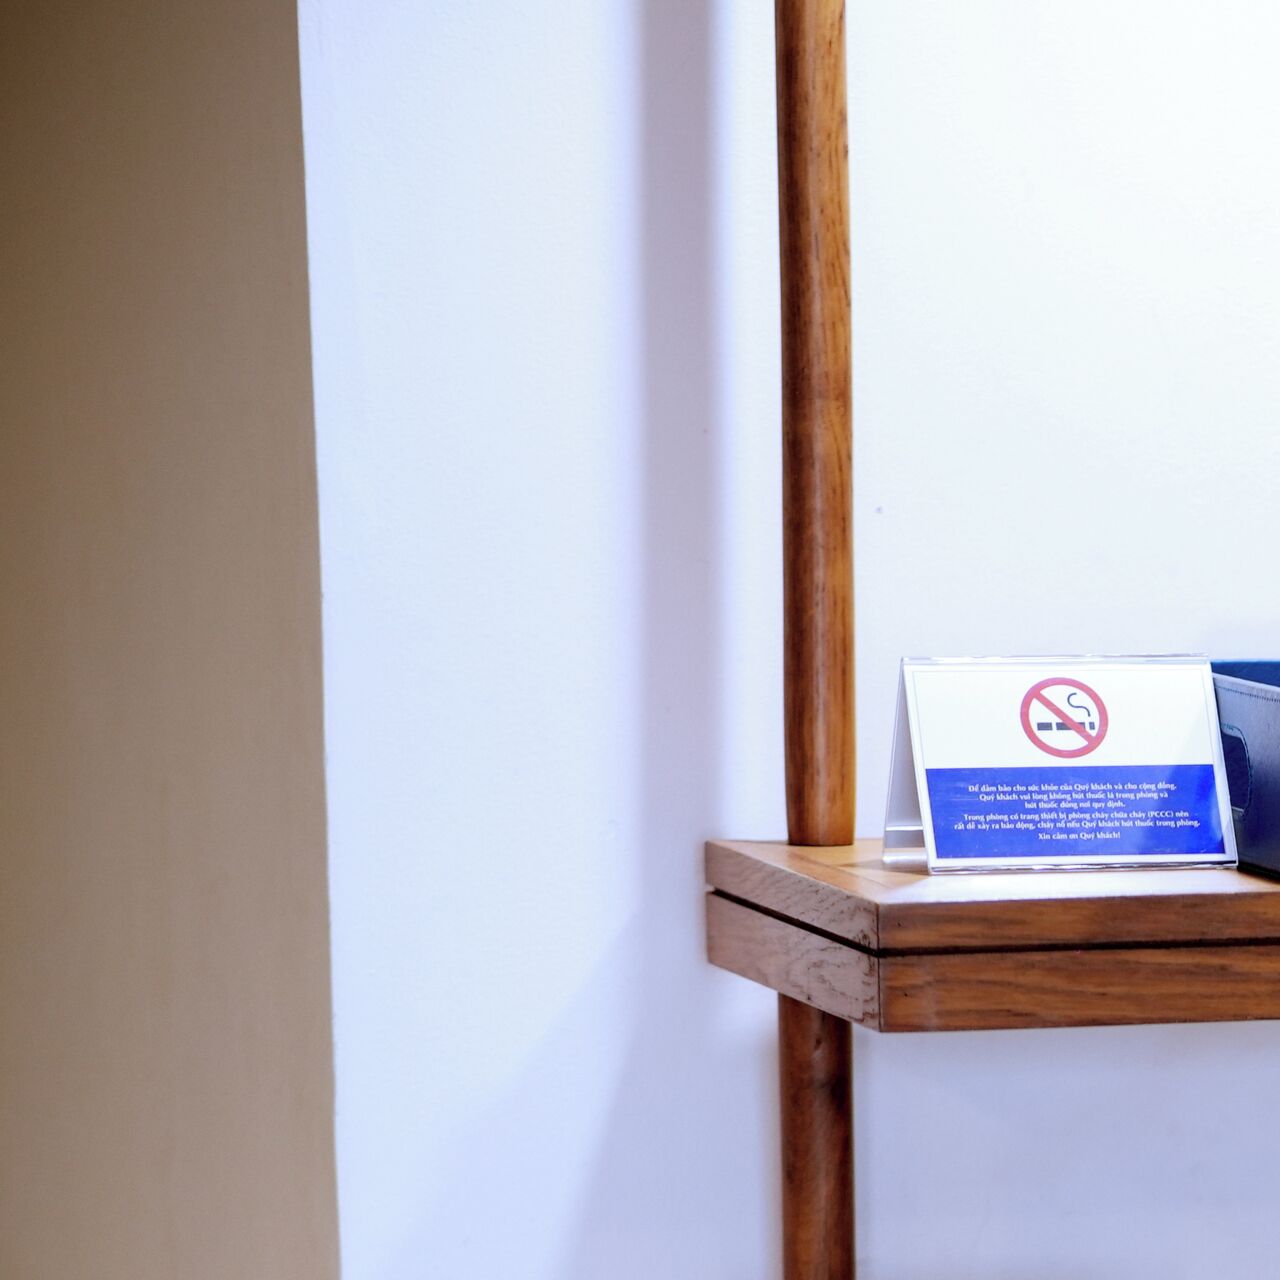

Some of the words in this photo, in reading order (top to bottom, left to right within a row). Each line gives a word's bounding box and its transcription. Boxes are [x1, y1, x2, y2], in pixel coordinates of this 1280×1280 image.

[1091, 782, 1112, 790] khách
[1124, 782, 1137, 790] cho
[1139, 782, 1156, 791] cộng
[1032, 792, 1048, 801] lòng
[1049, 792, 1071, 801] không
[1086, 791, 1105, 799] thuốc
[1116, 792, 1135, 800] trong
[1136, 792, 1158, 800] phòng
[1060, 801, 1078, 809] đúng
[986, 814, 1008, 822] phòng
[1068, 812, 1090, 820] phòng
[1092, 812, 1109, 820] cháy
[1129, 811, 1146, 819] cháy
[1038, 821, 1054, 829] cháy
[1135, 819, 1154, 827] thuốc
[1080, 832, 1094, 840] Quý
